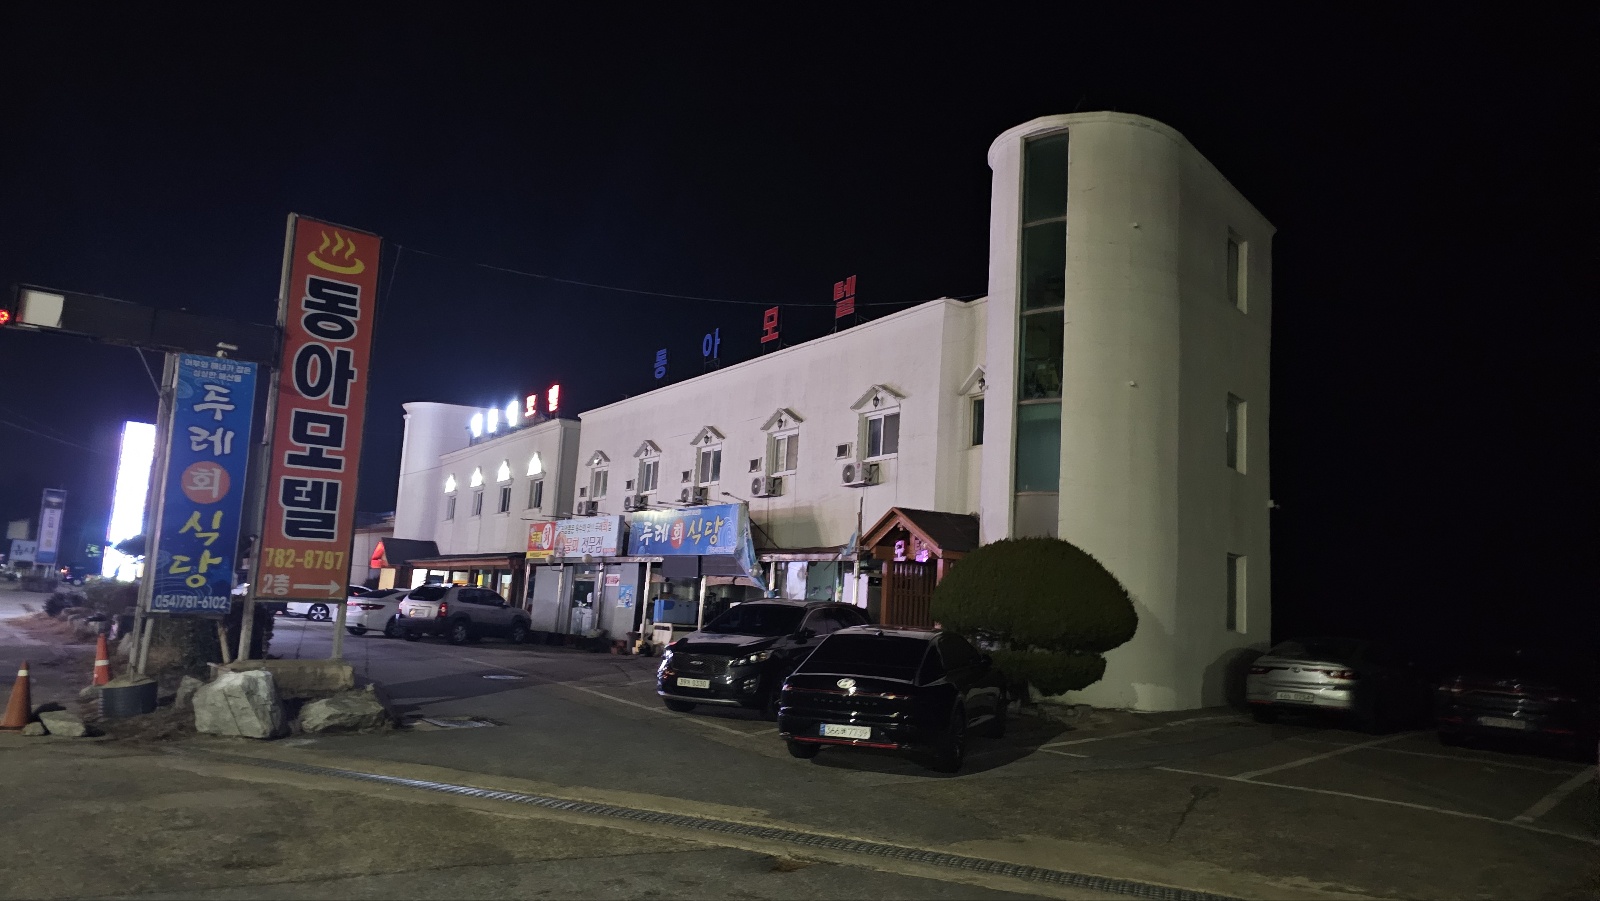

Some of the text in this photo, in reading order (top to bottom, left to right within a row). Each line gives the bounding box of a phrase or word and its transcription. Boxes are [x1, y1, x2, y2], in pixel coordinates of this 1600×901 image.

[654, 274, 857, 379] 동아모텔
[278, 274, 361, 543] 동아모텔
[582, 536, 604, 553] 전문점
[264, 548, 344, 570] 782-8797
[262, 573, 290, 596] 2층
